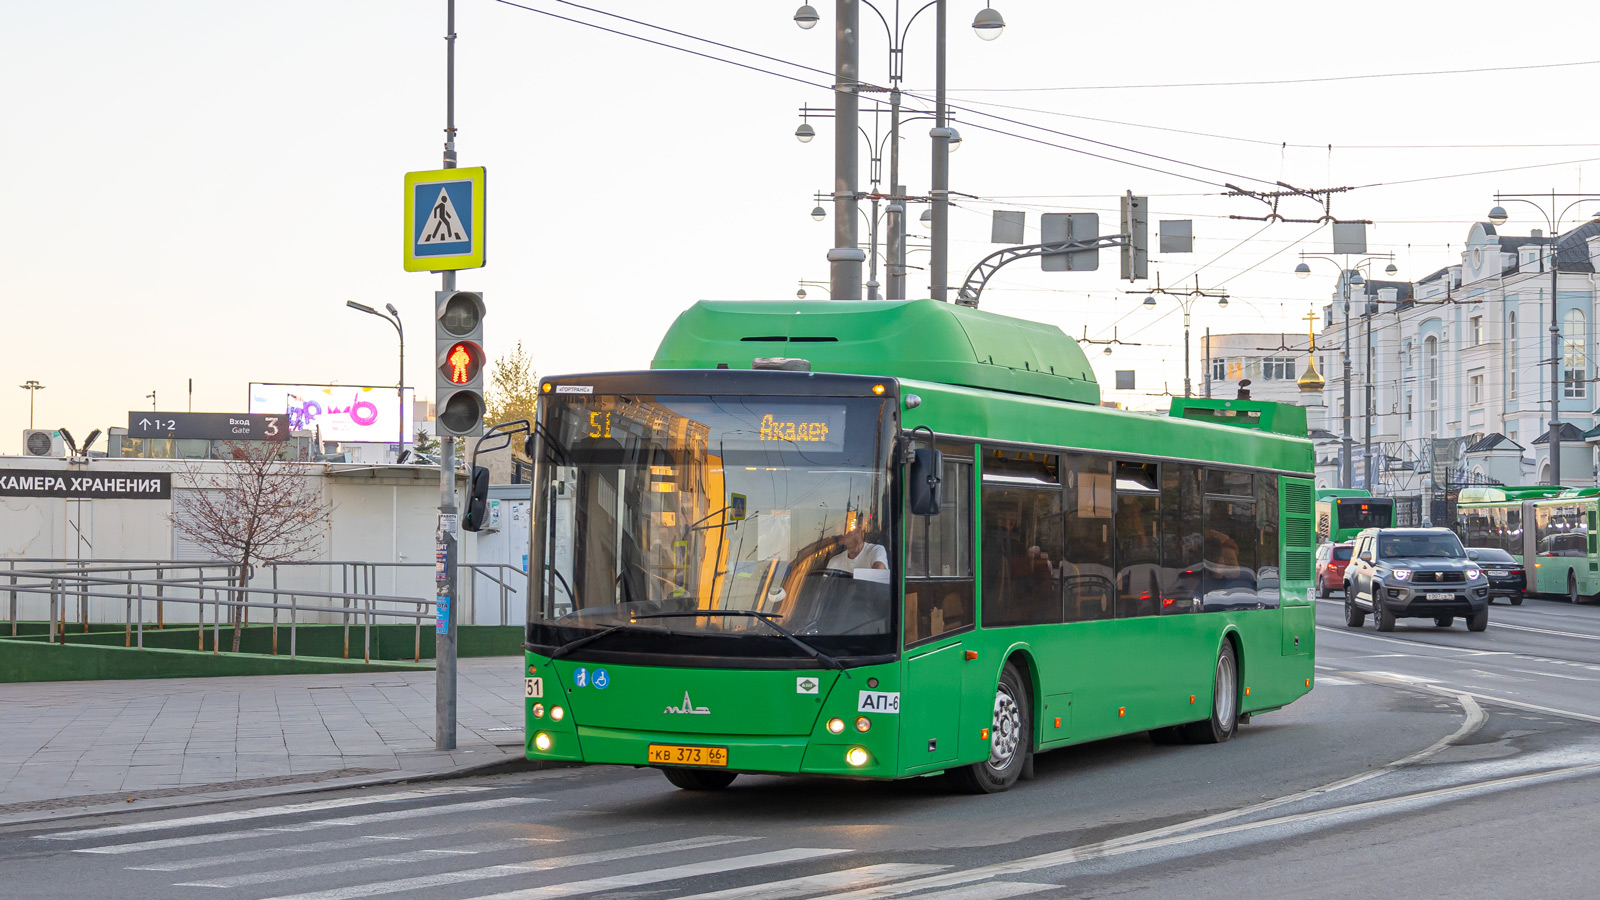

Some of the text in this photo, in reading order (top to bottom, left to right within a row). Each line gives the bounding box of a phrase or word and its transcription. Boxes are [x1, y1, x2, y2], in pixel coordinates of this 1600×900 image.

[229, 418, 250, 426] Вход
[232, 426, 250, 434] Gate
[264, 417, 279, 436] 3
[589, 412, 611, 438] 51
[0, 476, 161, 492] КАМЕРА ХРАНЕНИЯ
[524, 679, 540, 696] 51
[861, 694, 899, 710] АП-6
[655, 748, 722, 762] КВ 373 66
